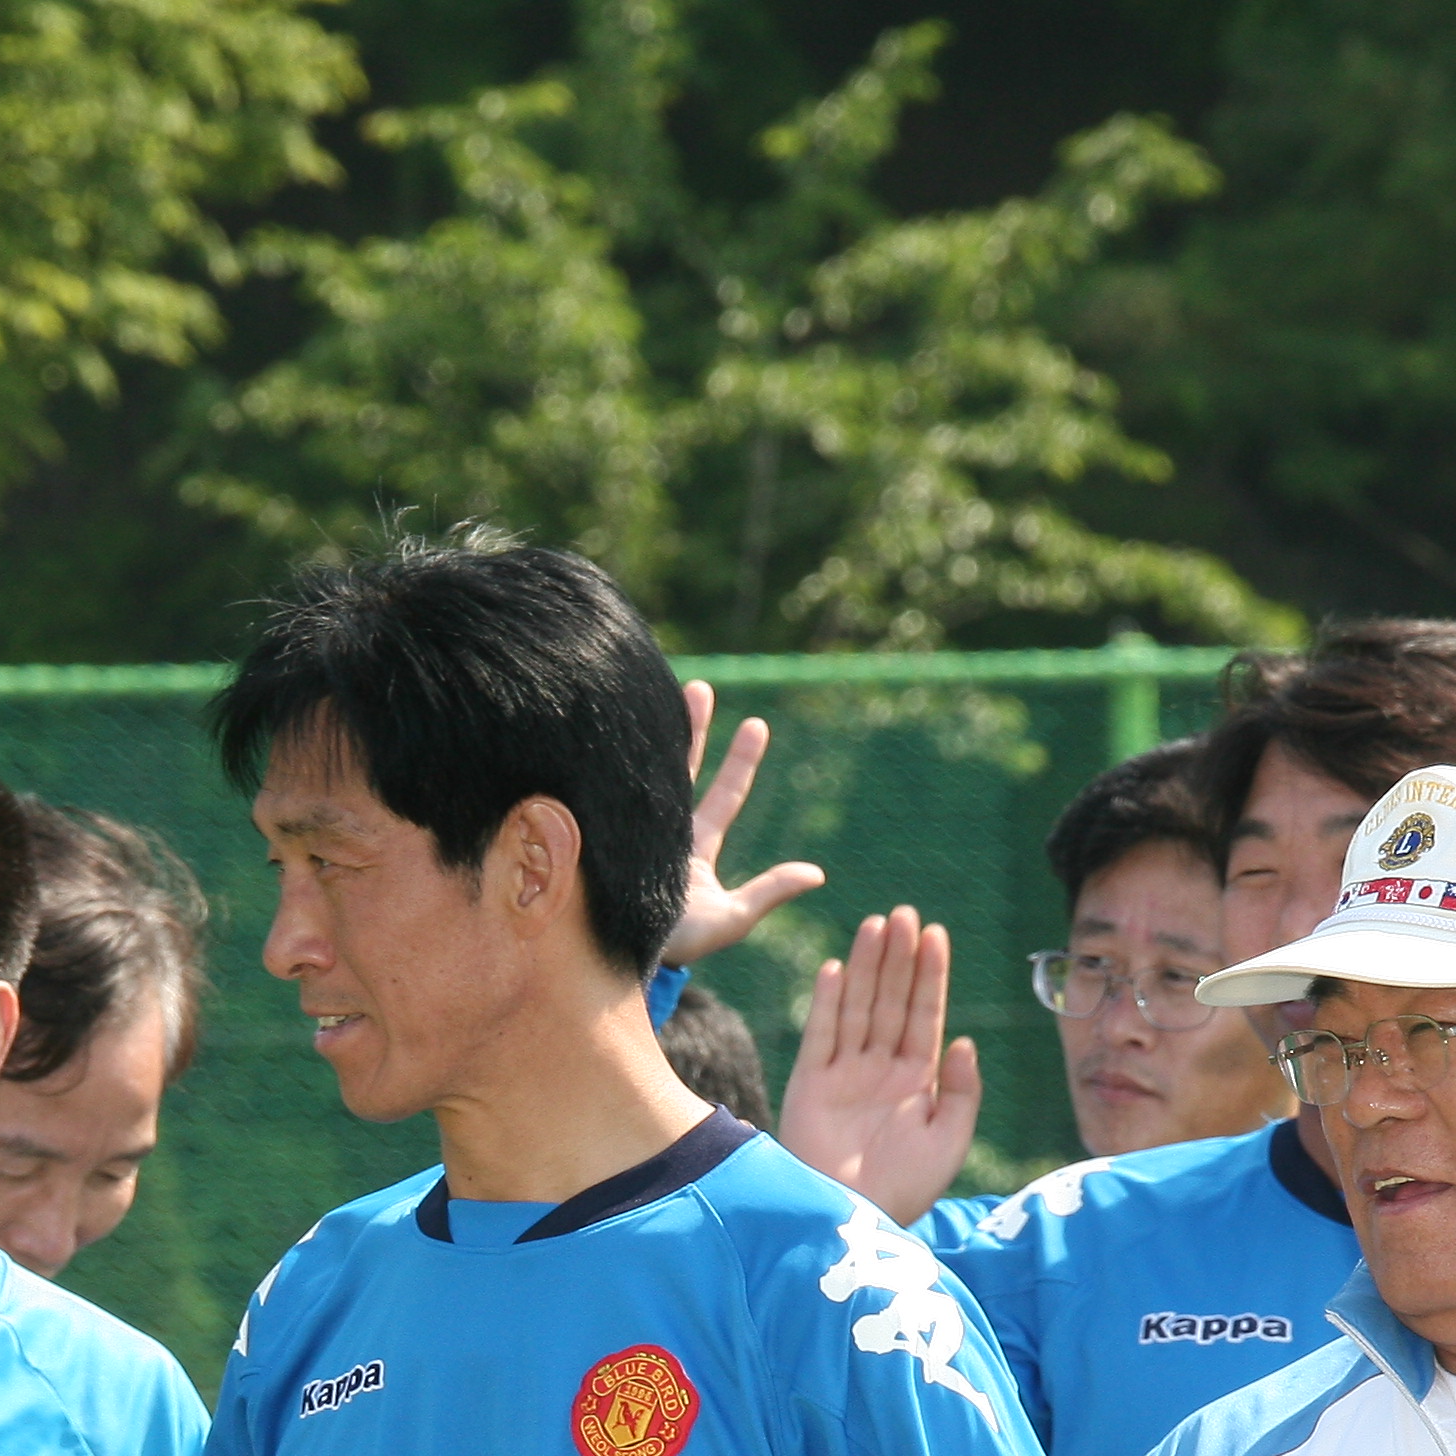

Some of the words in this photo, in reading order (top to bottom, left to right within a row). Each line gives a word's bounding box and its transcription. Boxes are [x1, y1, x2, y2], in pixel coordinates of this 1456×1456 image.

[1396, 831, 1412, 855] L
[1140, 1312, 1293, 1345] Kappa
[300, 1359, 384, 1419] Kappa
[604, 1362, 647, 1388] BLUE
[651, 1368, 679, 1411] BIRD
